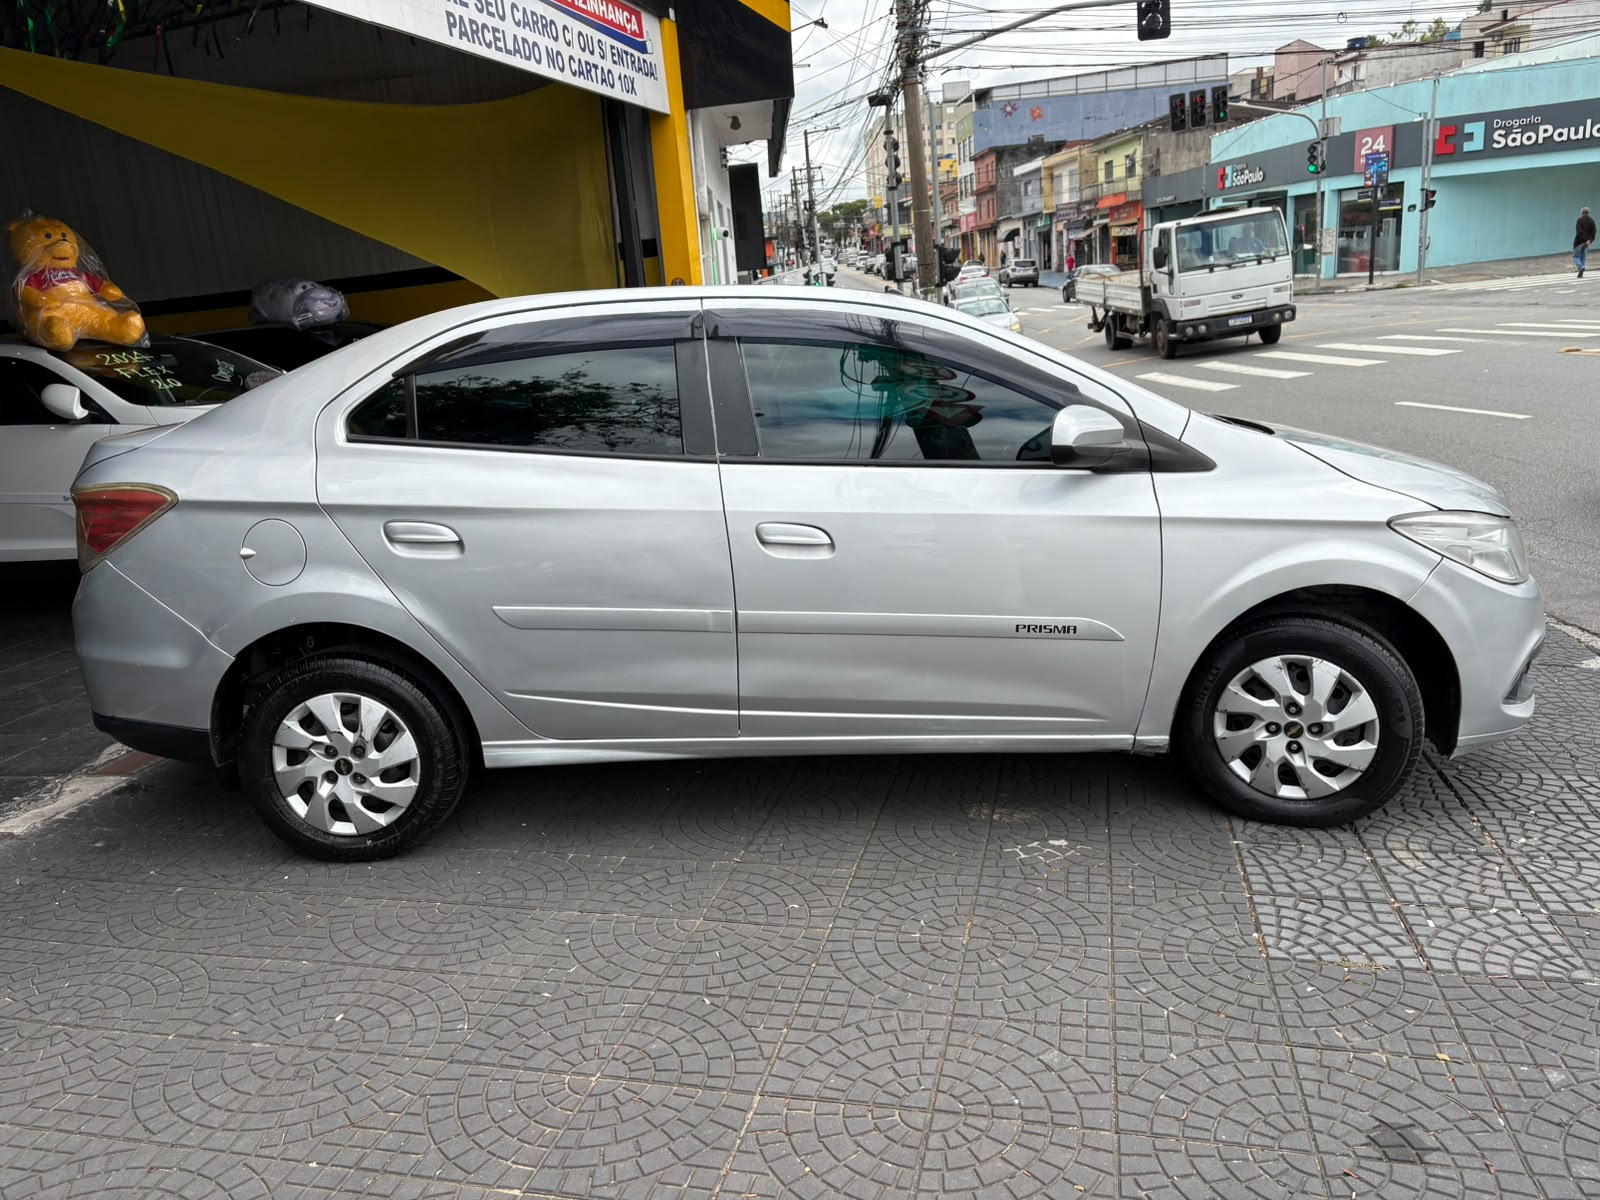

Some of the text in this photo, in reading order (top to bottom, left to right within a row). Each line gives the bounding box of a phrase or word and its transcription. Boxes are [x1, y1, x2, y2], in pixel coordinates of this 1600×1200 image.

[568, 0, 639, 33] ZINHANÇA
[445, 10, 542, 65] PARCELADO
[545, 45, 565, 73] NO
[618, 72, 637, 96] 10X
[474, 0, 506, 22] SEU
[510, 2, 559, 42] CARRO
[577, 31, 595, 56] OU
[610, 45, 658, 81] ENTRADA!
[1493, 115, 1541, 128] Drogaria
[1361, 134, 1386, 155] 24
[1015, 624, 1078, 634] PRISMA
